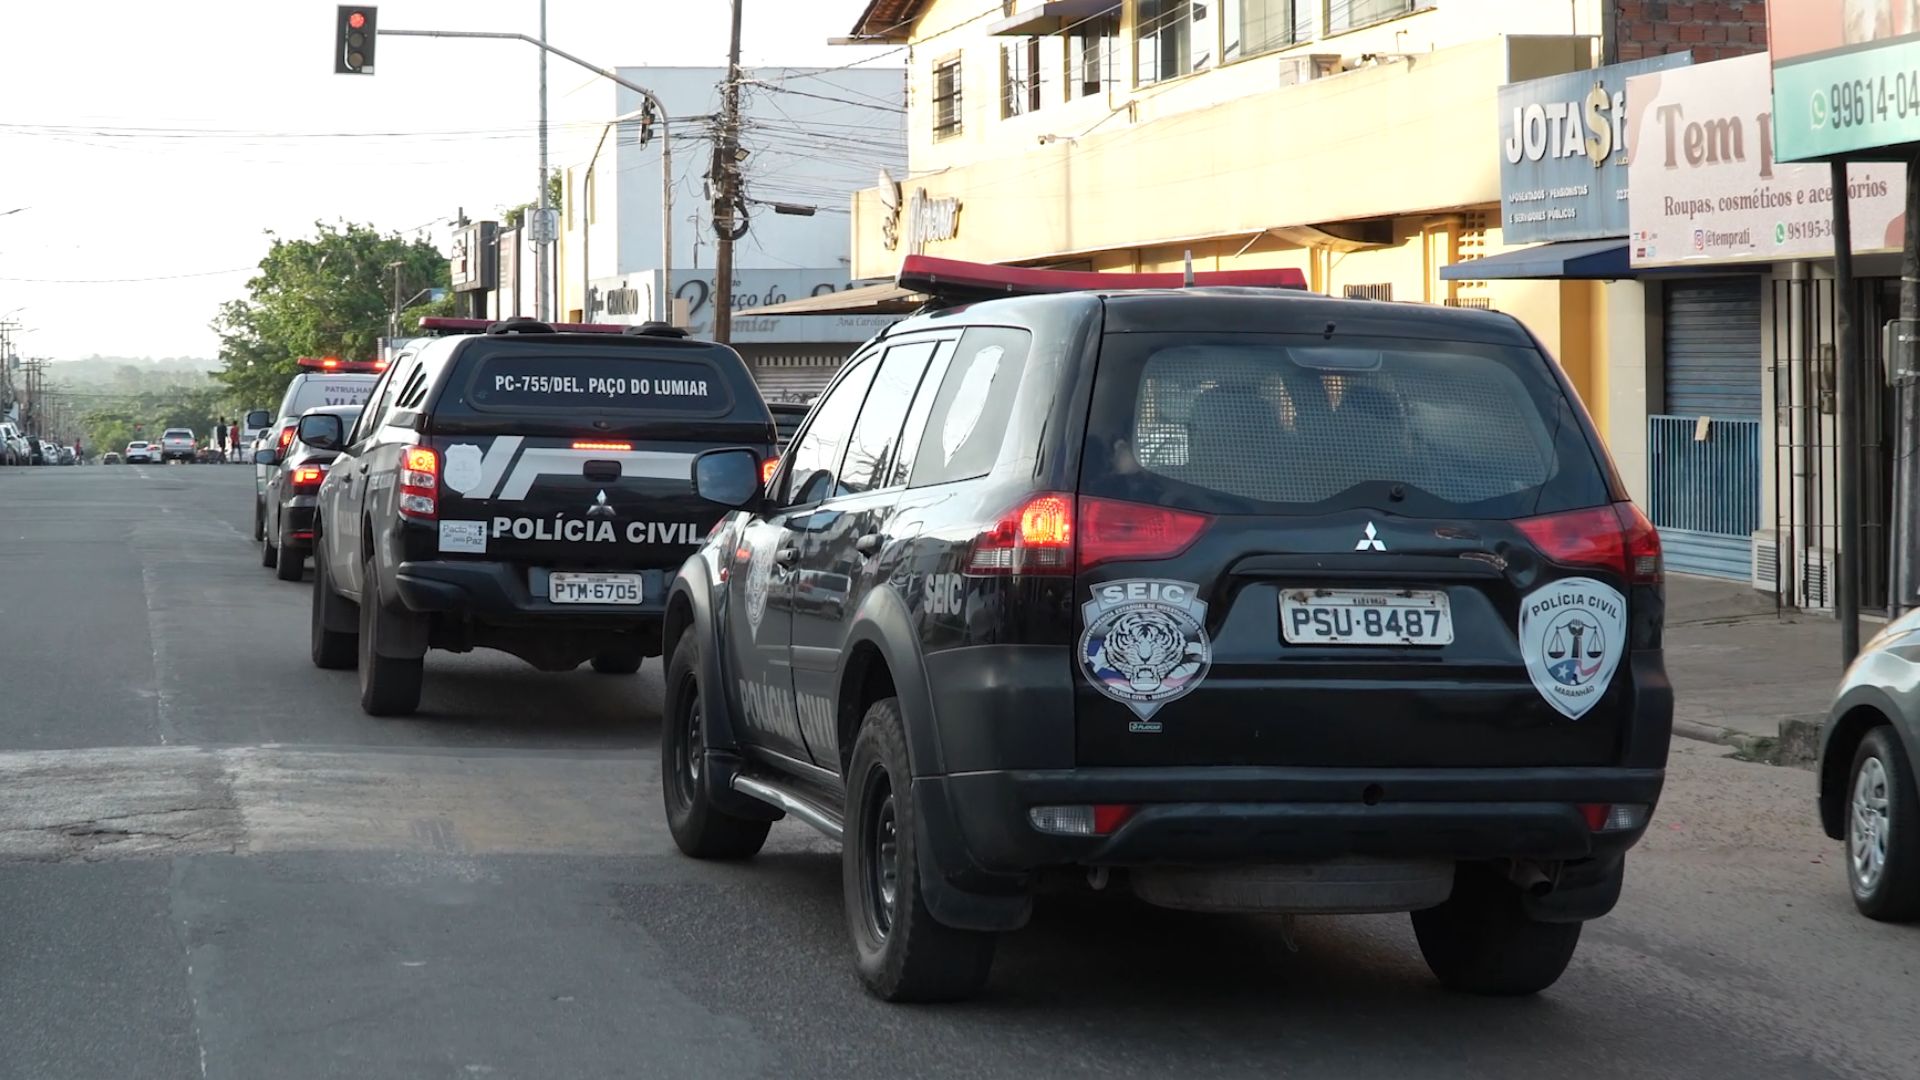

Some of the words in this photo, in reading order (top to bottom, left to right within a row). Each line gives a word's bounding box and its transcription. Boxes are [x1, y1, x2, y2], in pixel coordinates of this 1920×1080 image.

[1656, 103, 1745, 170] Tem
[1664, 195, 1715, 220] Roupas,
[1718, 187, 1792, 212] cosméticos
[1796, 189, 1804, 205] e
[1809, 174, 1887, 203] aceórios
[763, 285, 787, 306] do
[495, 375, 584, 394] PC-755/DEL.
[589, 378, 626, 397] PAÇO
[630, 379, 650, 394] DO
[655, 380, 708, 396] LUMIAR
[492, 512, 617, 543] POLÍCIA
[625, 521, 705, 545] CIVIL
[923, 573, 962, 615] SEIC
[1102, 583, 1185, 604] SEIC
[1531, 592, 1585, 617] POLÍCIA
[1588, 596, 1618, 619] CIVIL
[1554, 684, 1595, 697] MARANHÃO
[739, 670, 799, 740] POLÍCIA
[797, 691, 836, 750] CIVIL
